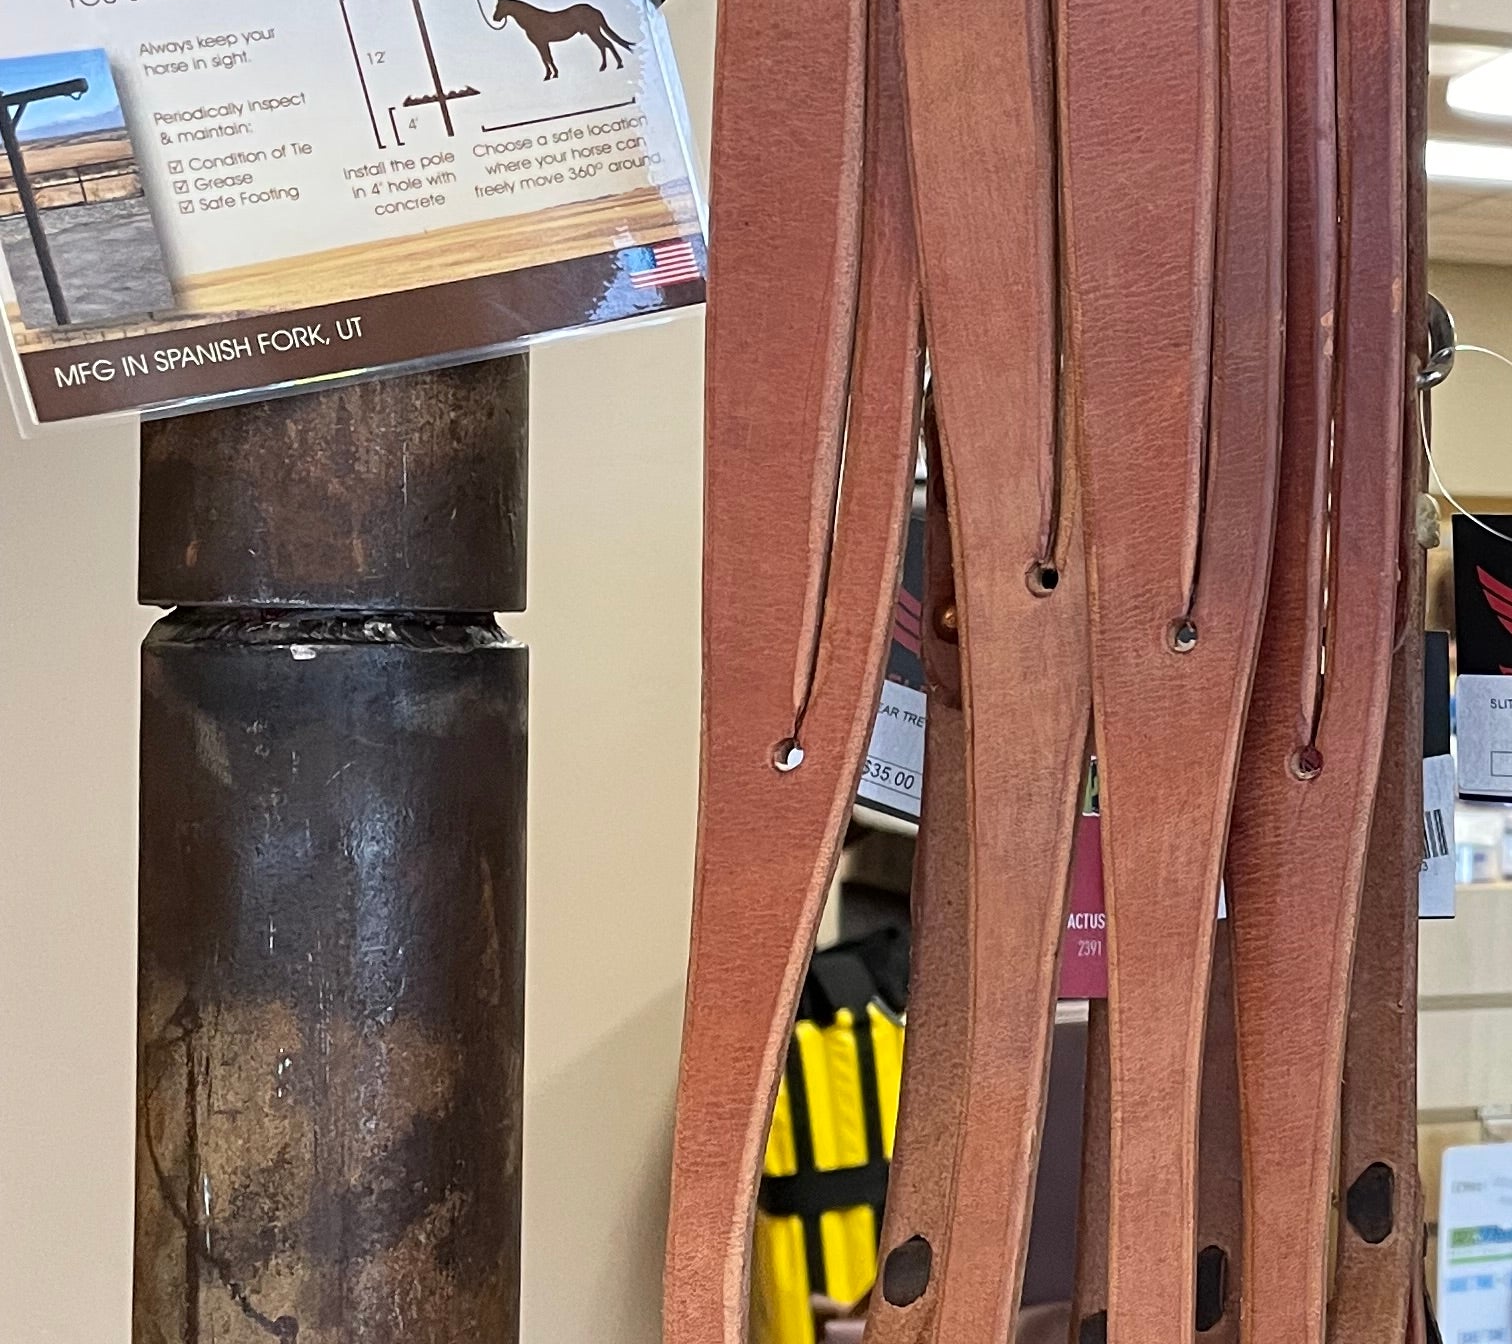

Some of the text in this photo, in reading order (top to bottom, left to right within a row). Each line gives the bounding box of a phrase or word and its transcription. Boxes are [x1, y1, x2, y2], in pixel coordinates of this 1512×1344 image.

[139, 27, 276, 56] Always keep your
[143, 59, 189, 77] horse
[193, 56, 207, 70] in
[153, 92, 307, 126] Periodically inspect
[160, 132, 173, 146] &
[472, 115, 649, 158] Choose a safe location
[188, 142, 313, 171] Condition of Tie
[343, 151, 455, 180] Install the pole
[485, 136, 647, 175] where your horse can
[194, 173, 254, 191] Grease
[351, 186, 367, 199] in
[388, 176, 423, 194] hole
[426, 170, 457, 187] with
[474, 179, 516, 198] freely
[520, 170, 565, 190] move
[199, 186, 300, 212] Safe Footing
[374, 193, 446, 216] concrete
[54, 316, 363, 388] MFG IN SPANISH FORK, UT
